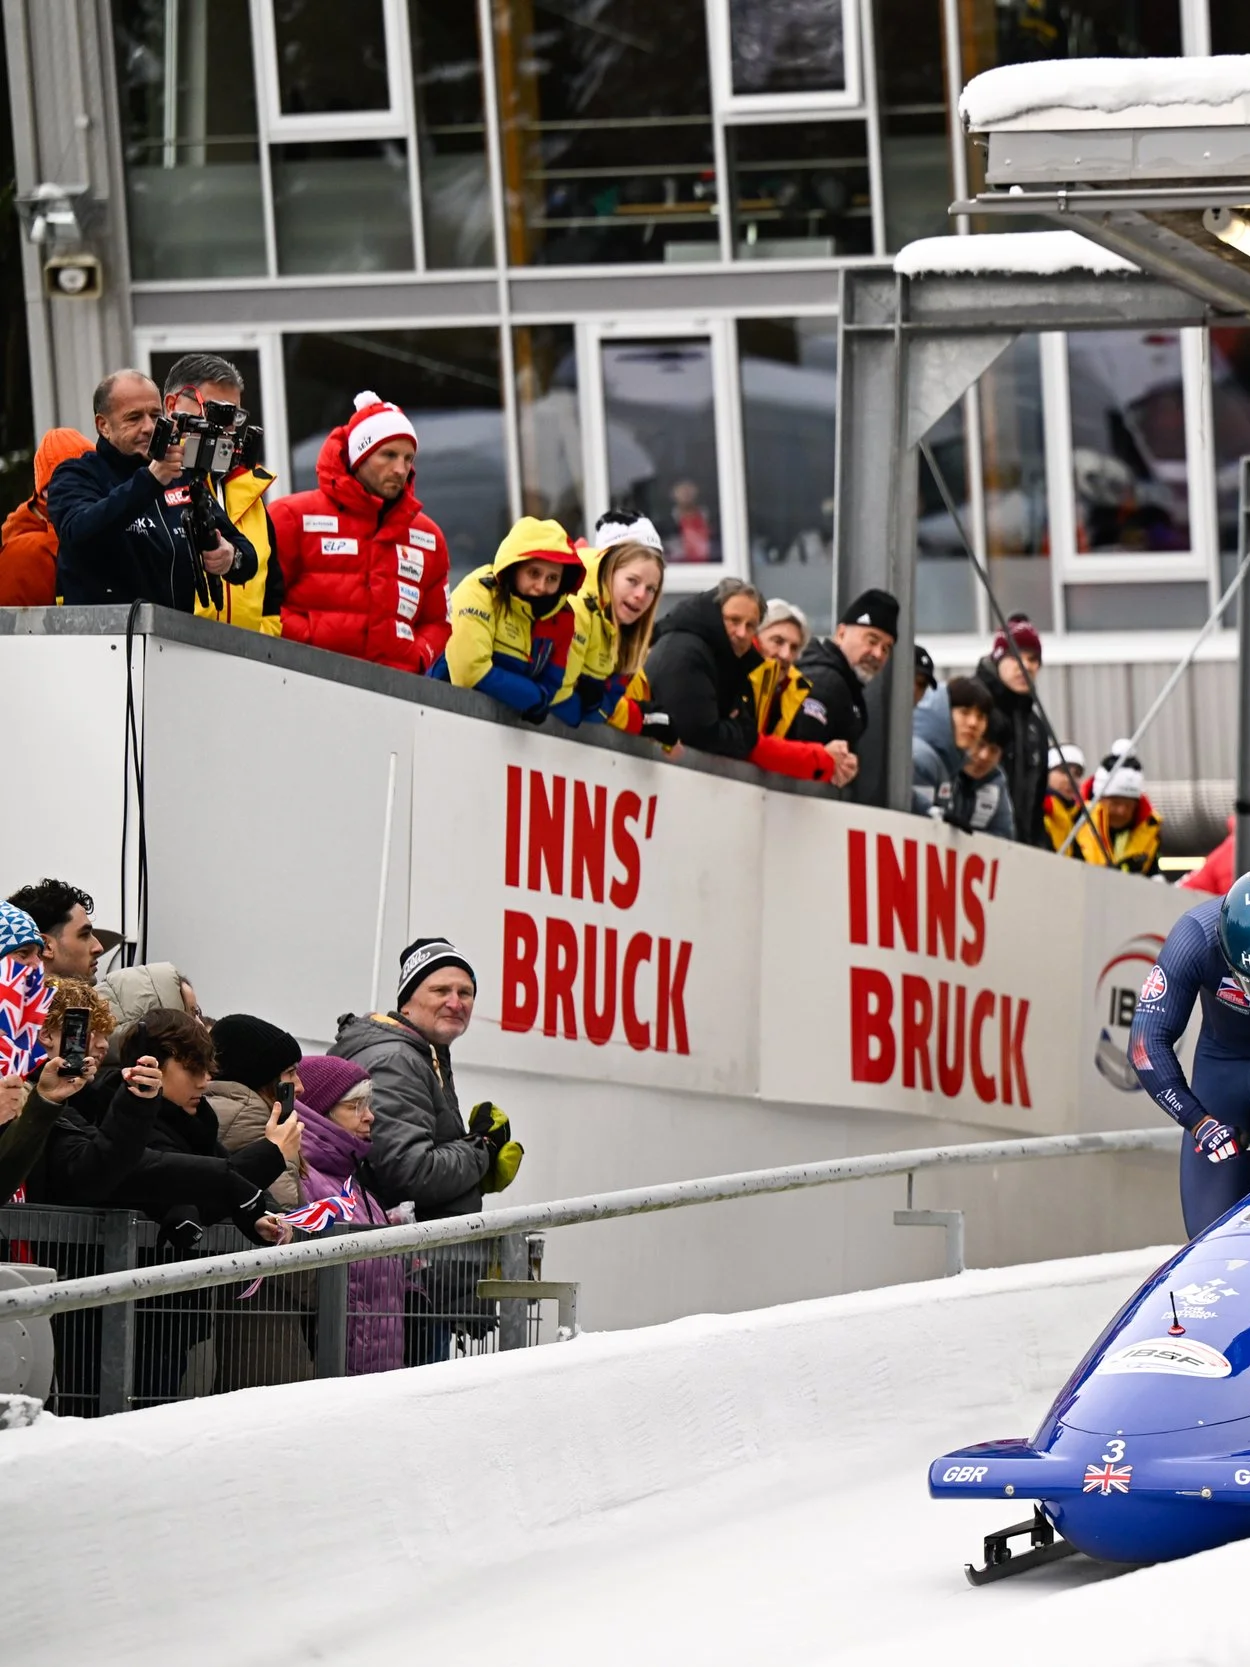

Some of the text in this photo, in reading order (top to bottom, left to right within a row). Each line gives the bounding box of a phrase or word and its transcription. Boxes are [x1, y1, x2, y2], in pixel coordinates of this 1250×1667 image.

[458, 608, 491, 623] ROMANIA
[504, 764, 658, 911] INNS'
[847, 828, 1000, 968] INNS'
[499, 908, 693, 1056] BRUCK
[1108, 985, 1138, 1028] IB
[849, 965, 1032, 1108] BRUCK
[1160, 1088, 1184, 1113] Altus
[1208, 1129, 1231, 1151] SEIZ
[1122, 1348, 1205, 1367] IBSF
[1102, 1439, 1126, 1463] 3
[942, 1466, 989, 1483] GBR
